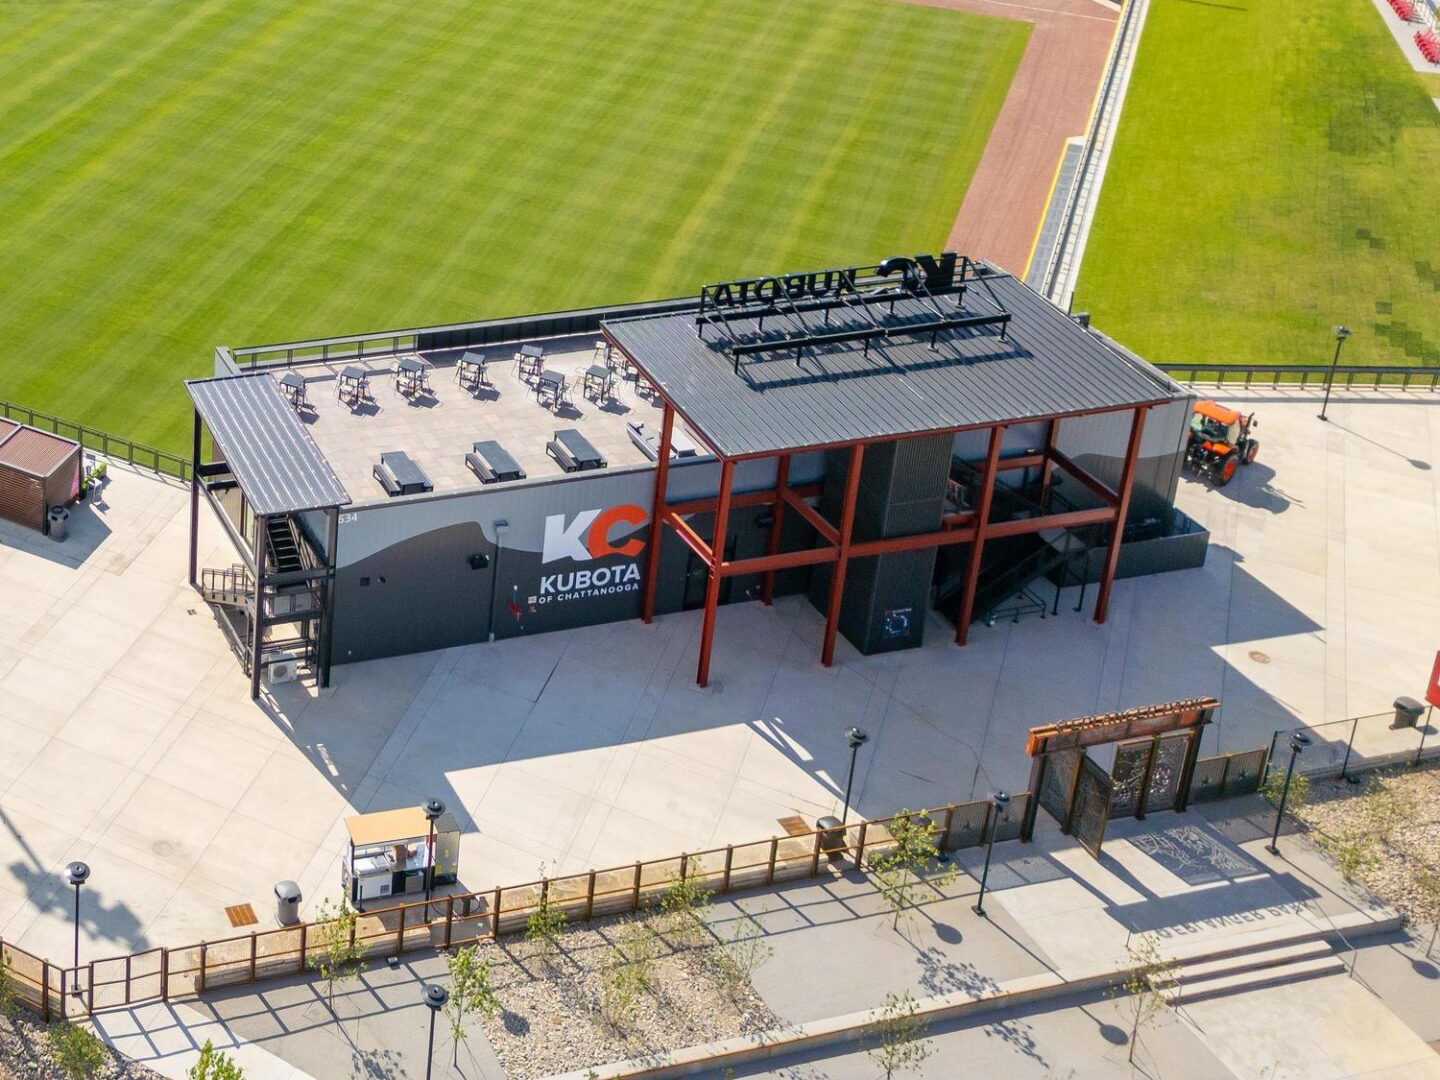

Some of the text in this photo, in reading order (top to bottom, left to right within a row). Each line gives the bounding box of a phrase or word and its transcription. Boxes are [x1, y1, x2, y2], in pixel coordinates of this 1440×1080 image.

[542, 504, 649, 565] KC
[539, 593, 553, 604] OF
[558, 583, 639, 601] CHATTANOOGA
[540, 563, 641, 595] KUBOTA
